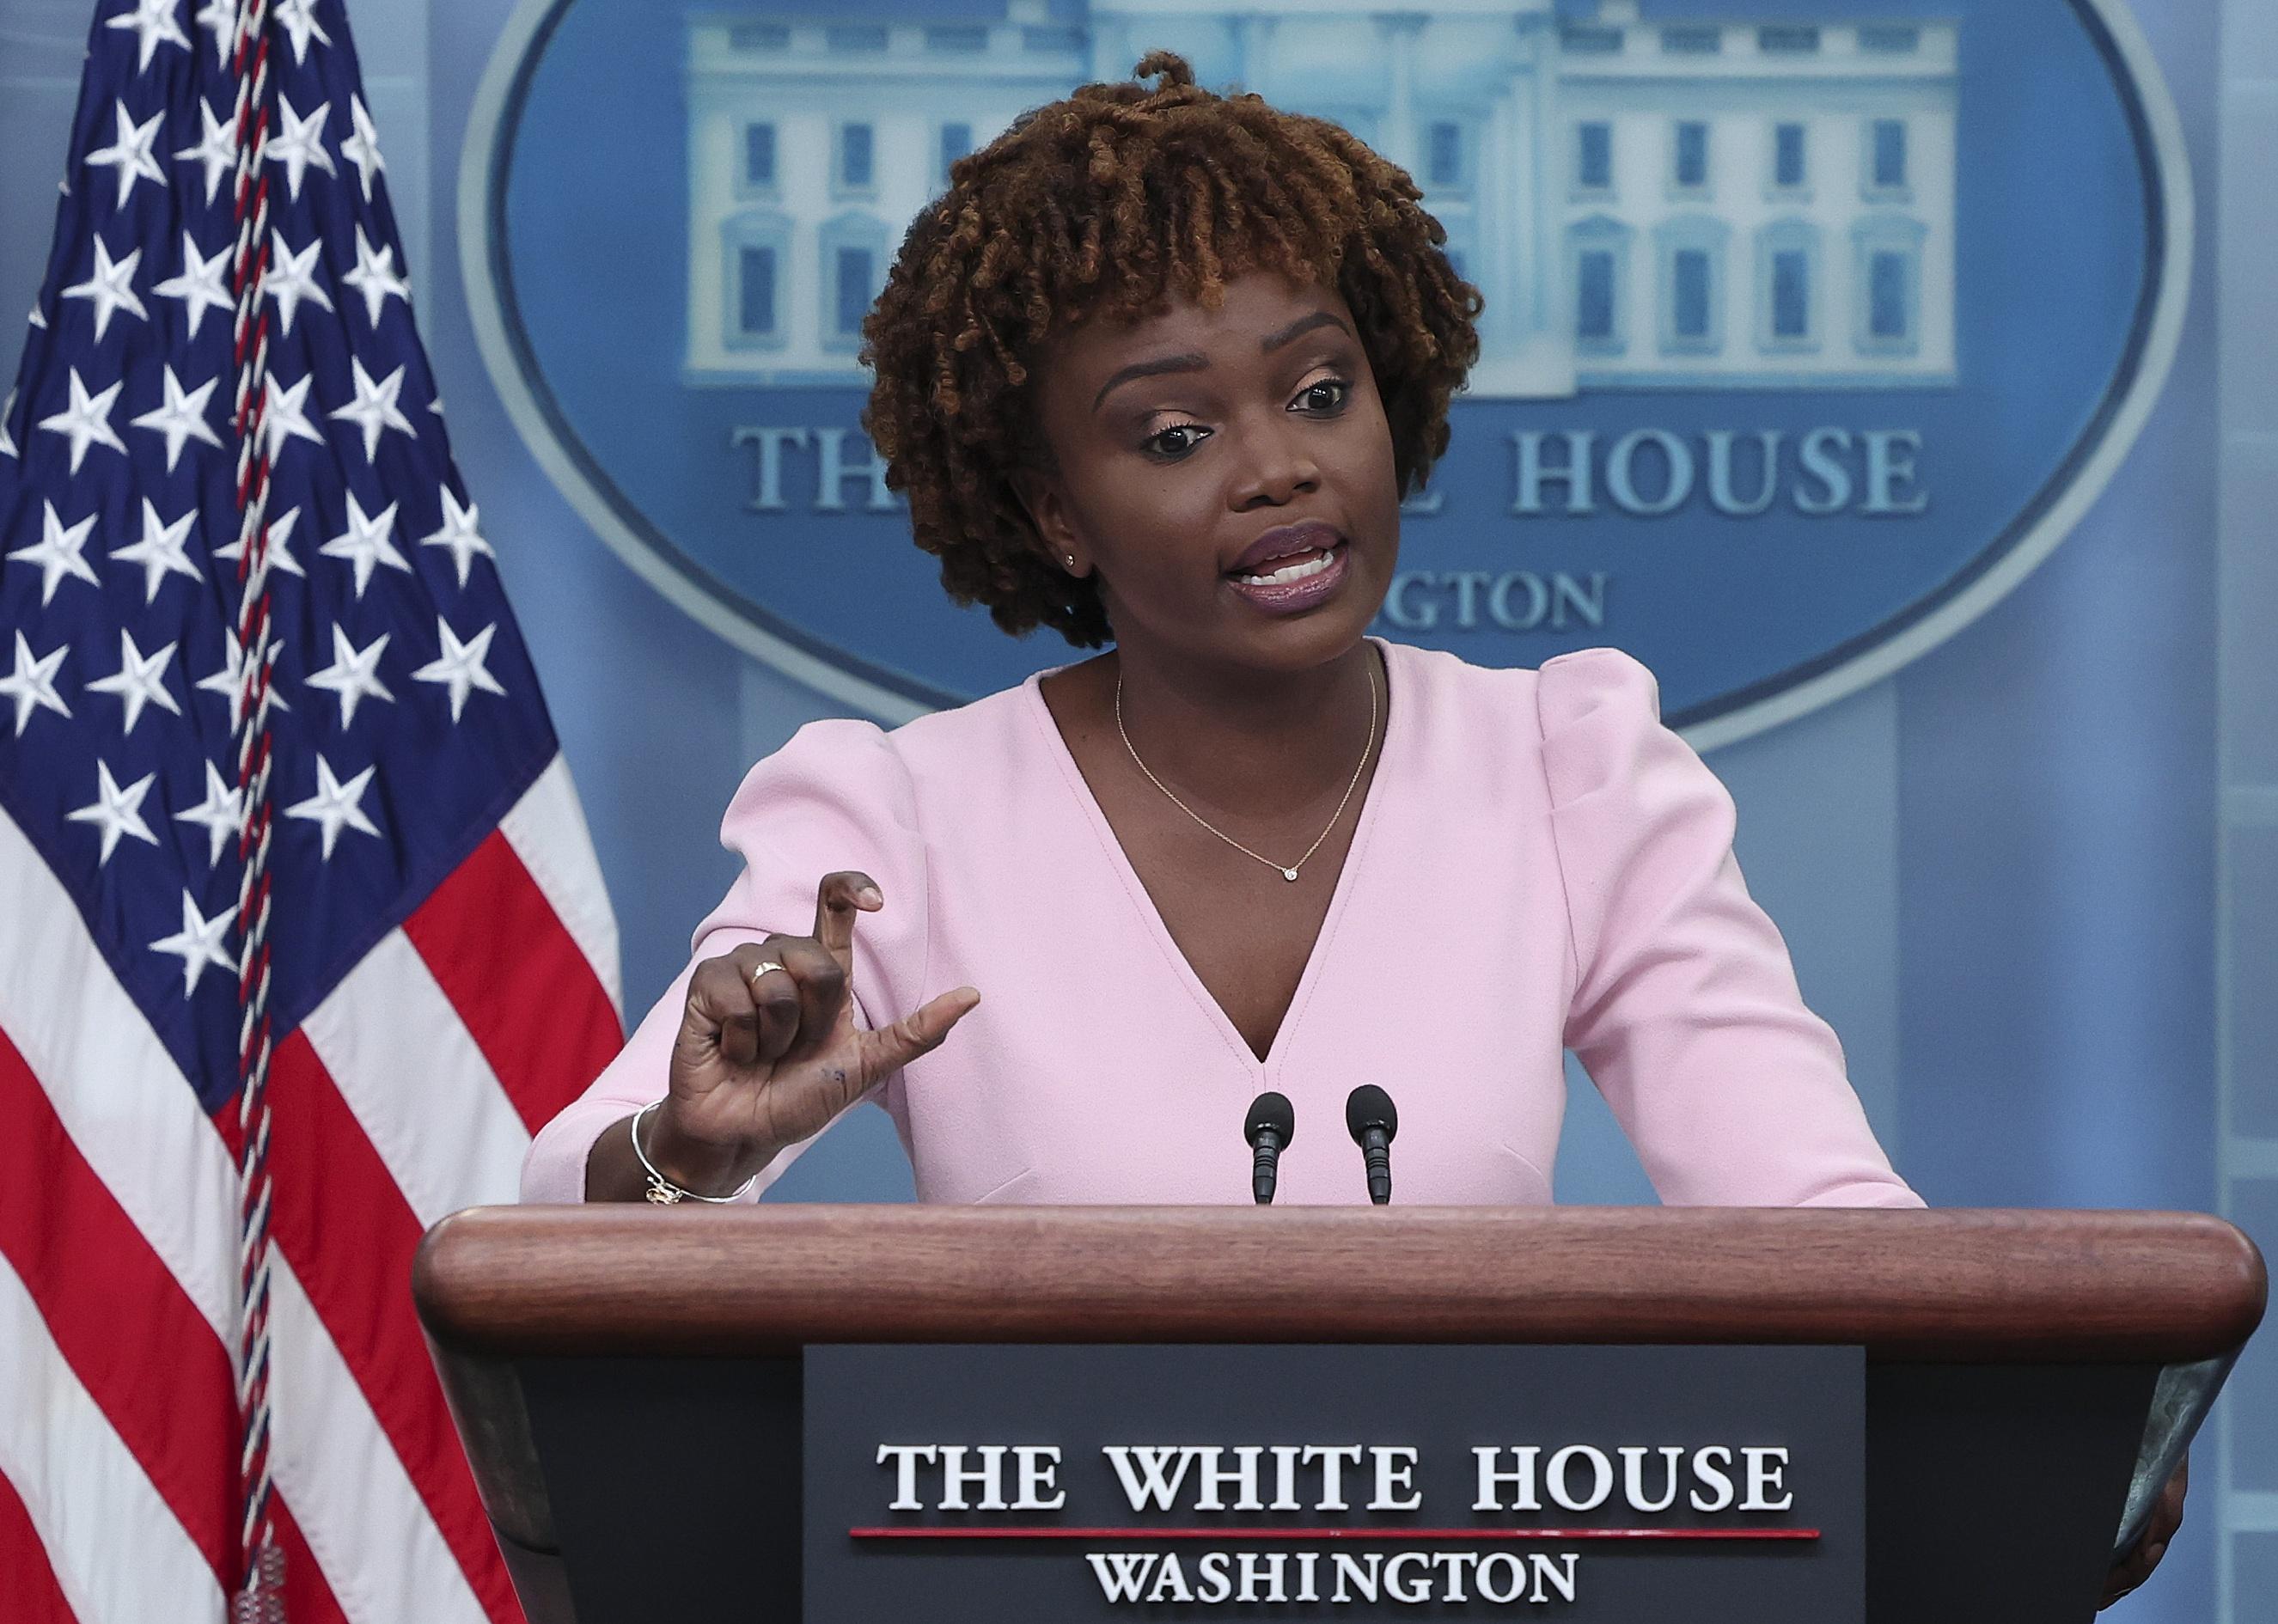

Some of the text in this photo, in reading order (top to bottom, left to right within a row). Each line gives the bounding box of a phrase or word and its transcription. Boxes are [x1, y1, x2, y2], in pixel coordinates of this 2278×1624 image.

[733, 427, 899, 509] TH
[1513, 428, 1928, 514] HOUSE
[876, 1444, 1793, 1511] THE WHITE HOUSE
[1085, 1552, 1579, 1604] WASHINGTON
